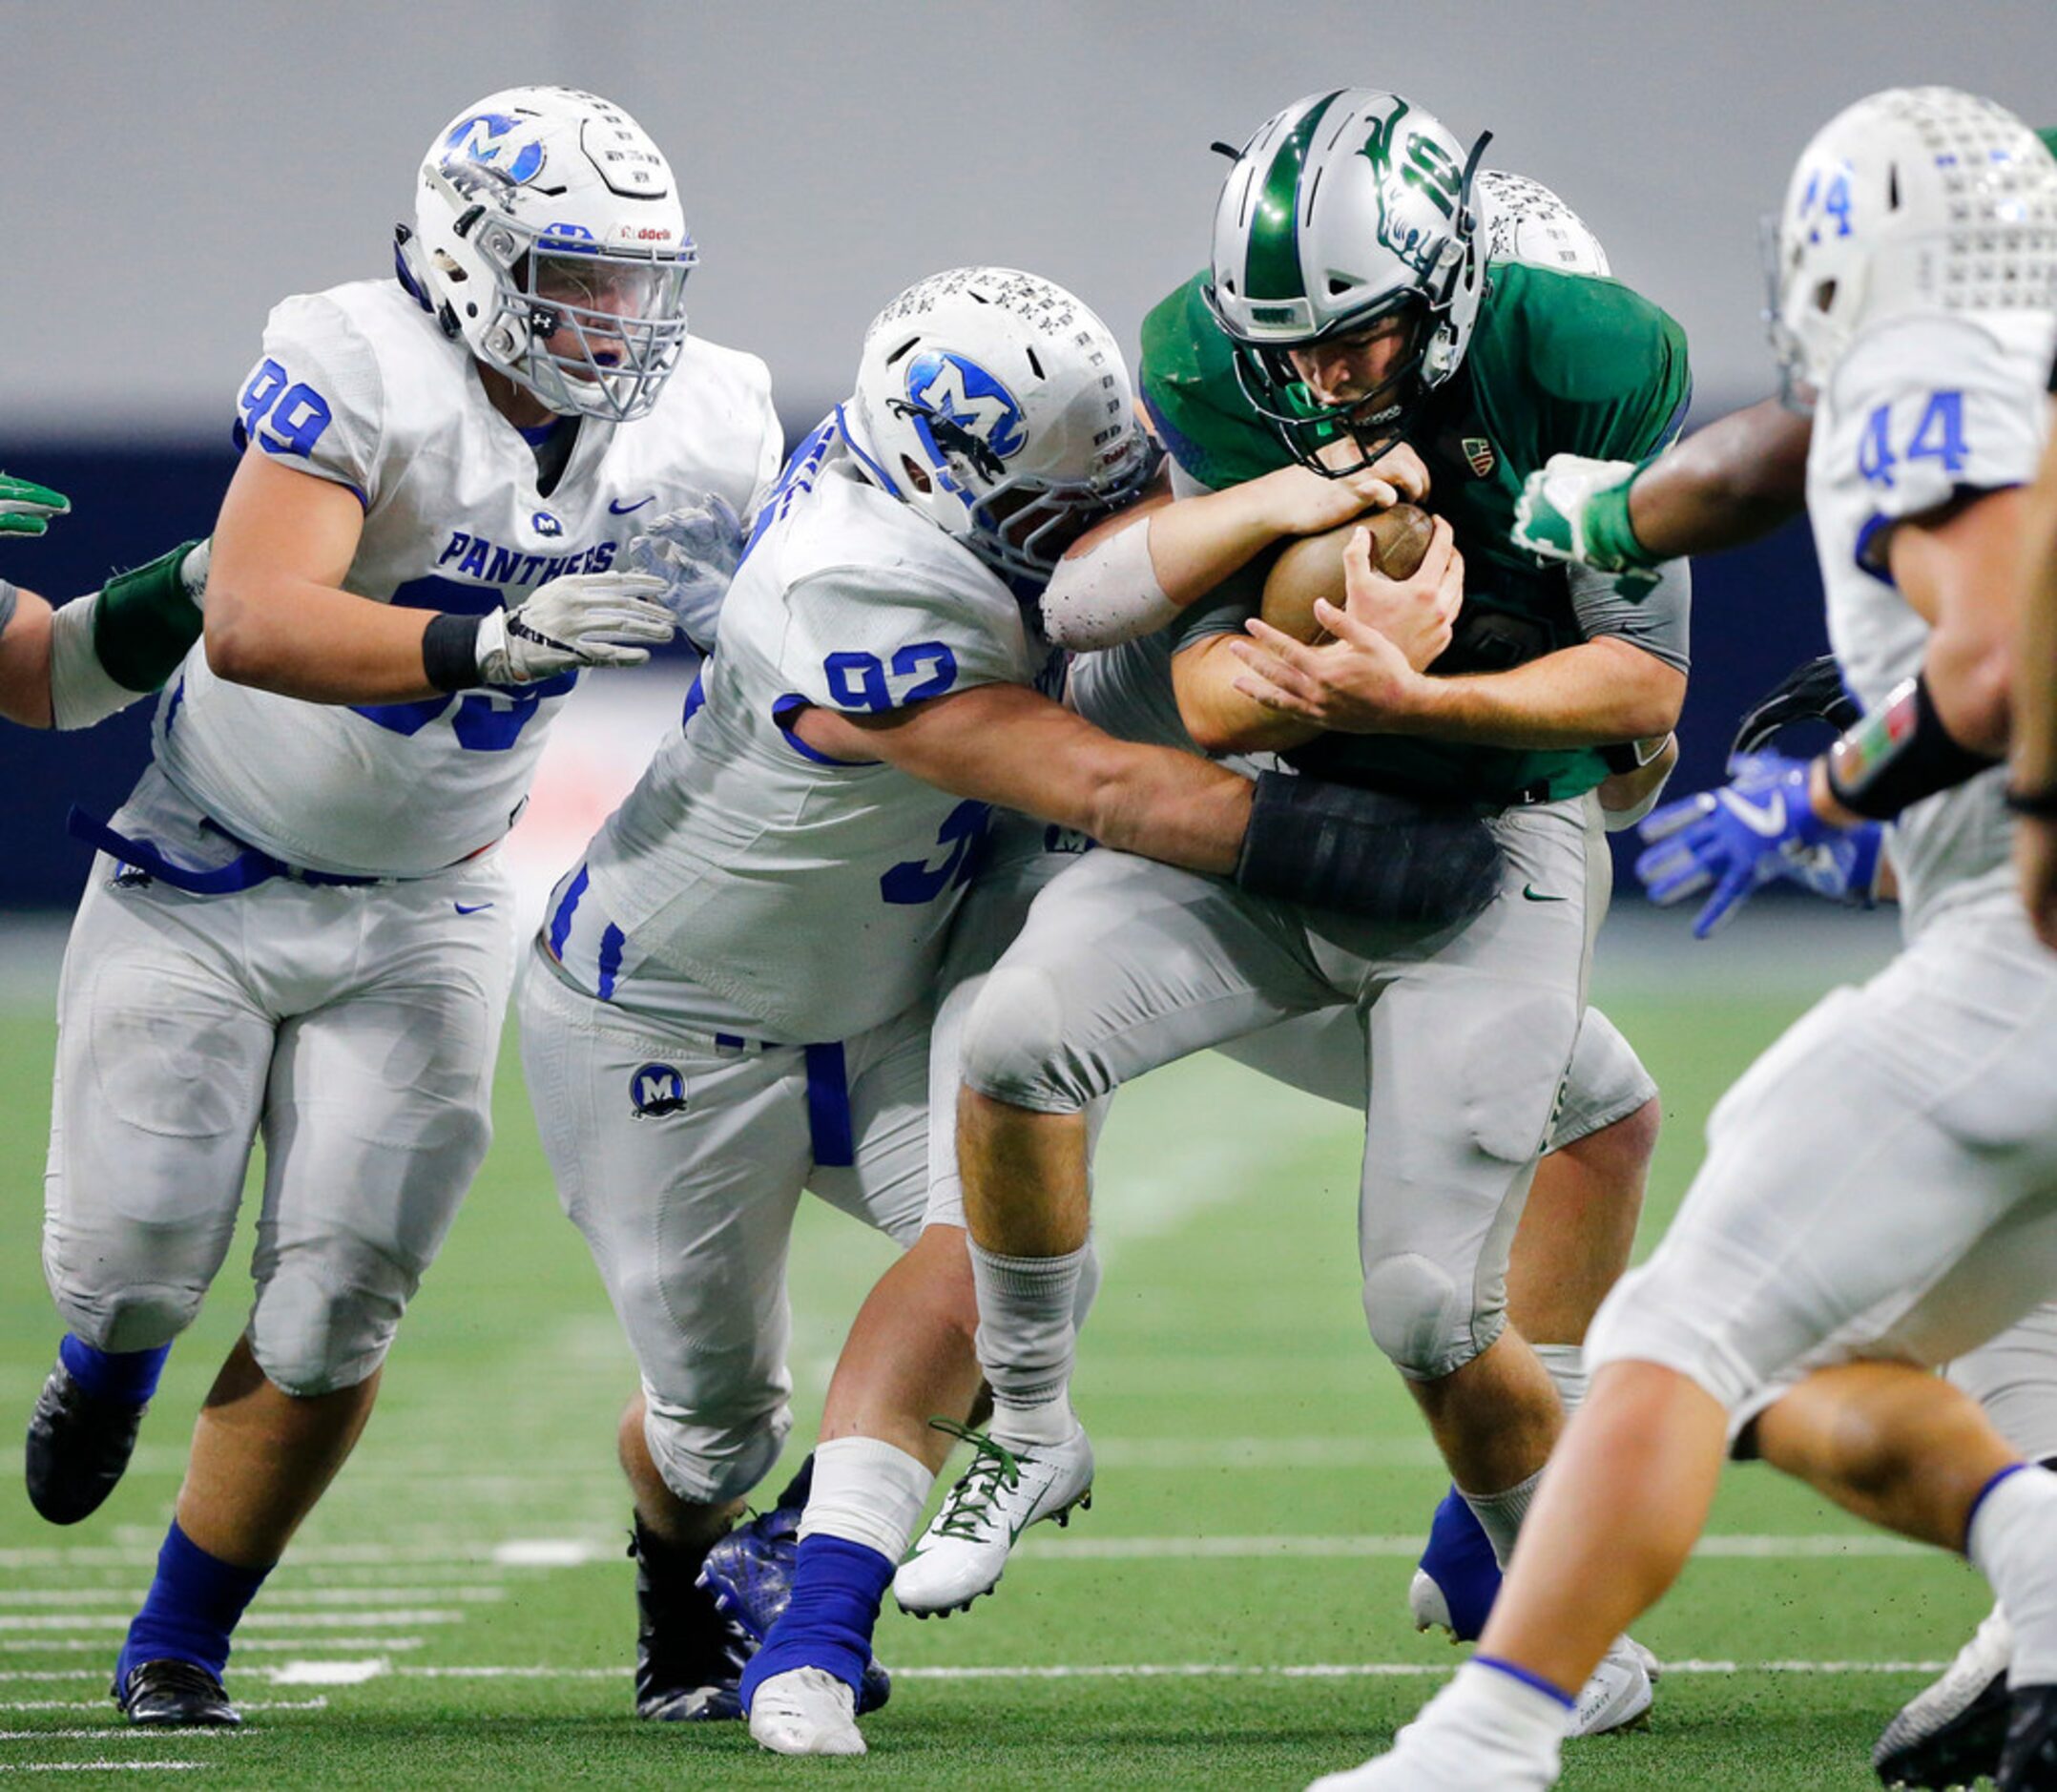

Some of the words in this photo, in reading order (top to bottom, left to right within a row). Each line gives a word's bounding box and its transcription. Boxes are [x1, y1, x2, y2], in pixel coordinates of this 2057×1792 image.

[240, 358, 332, 460] 99
[1858, 389, 1970, 489] 44
[822, 640, 958, 713] 92
[641, 1073, 674, 1106] M
